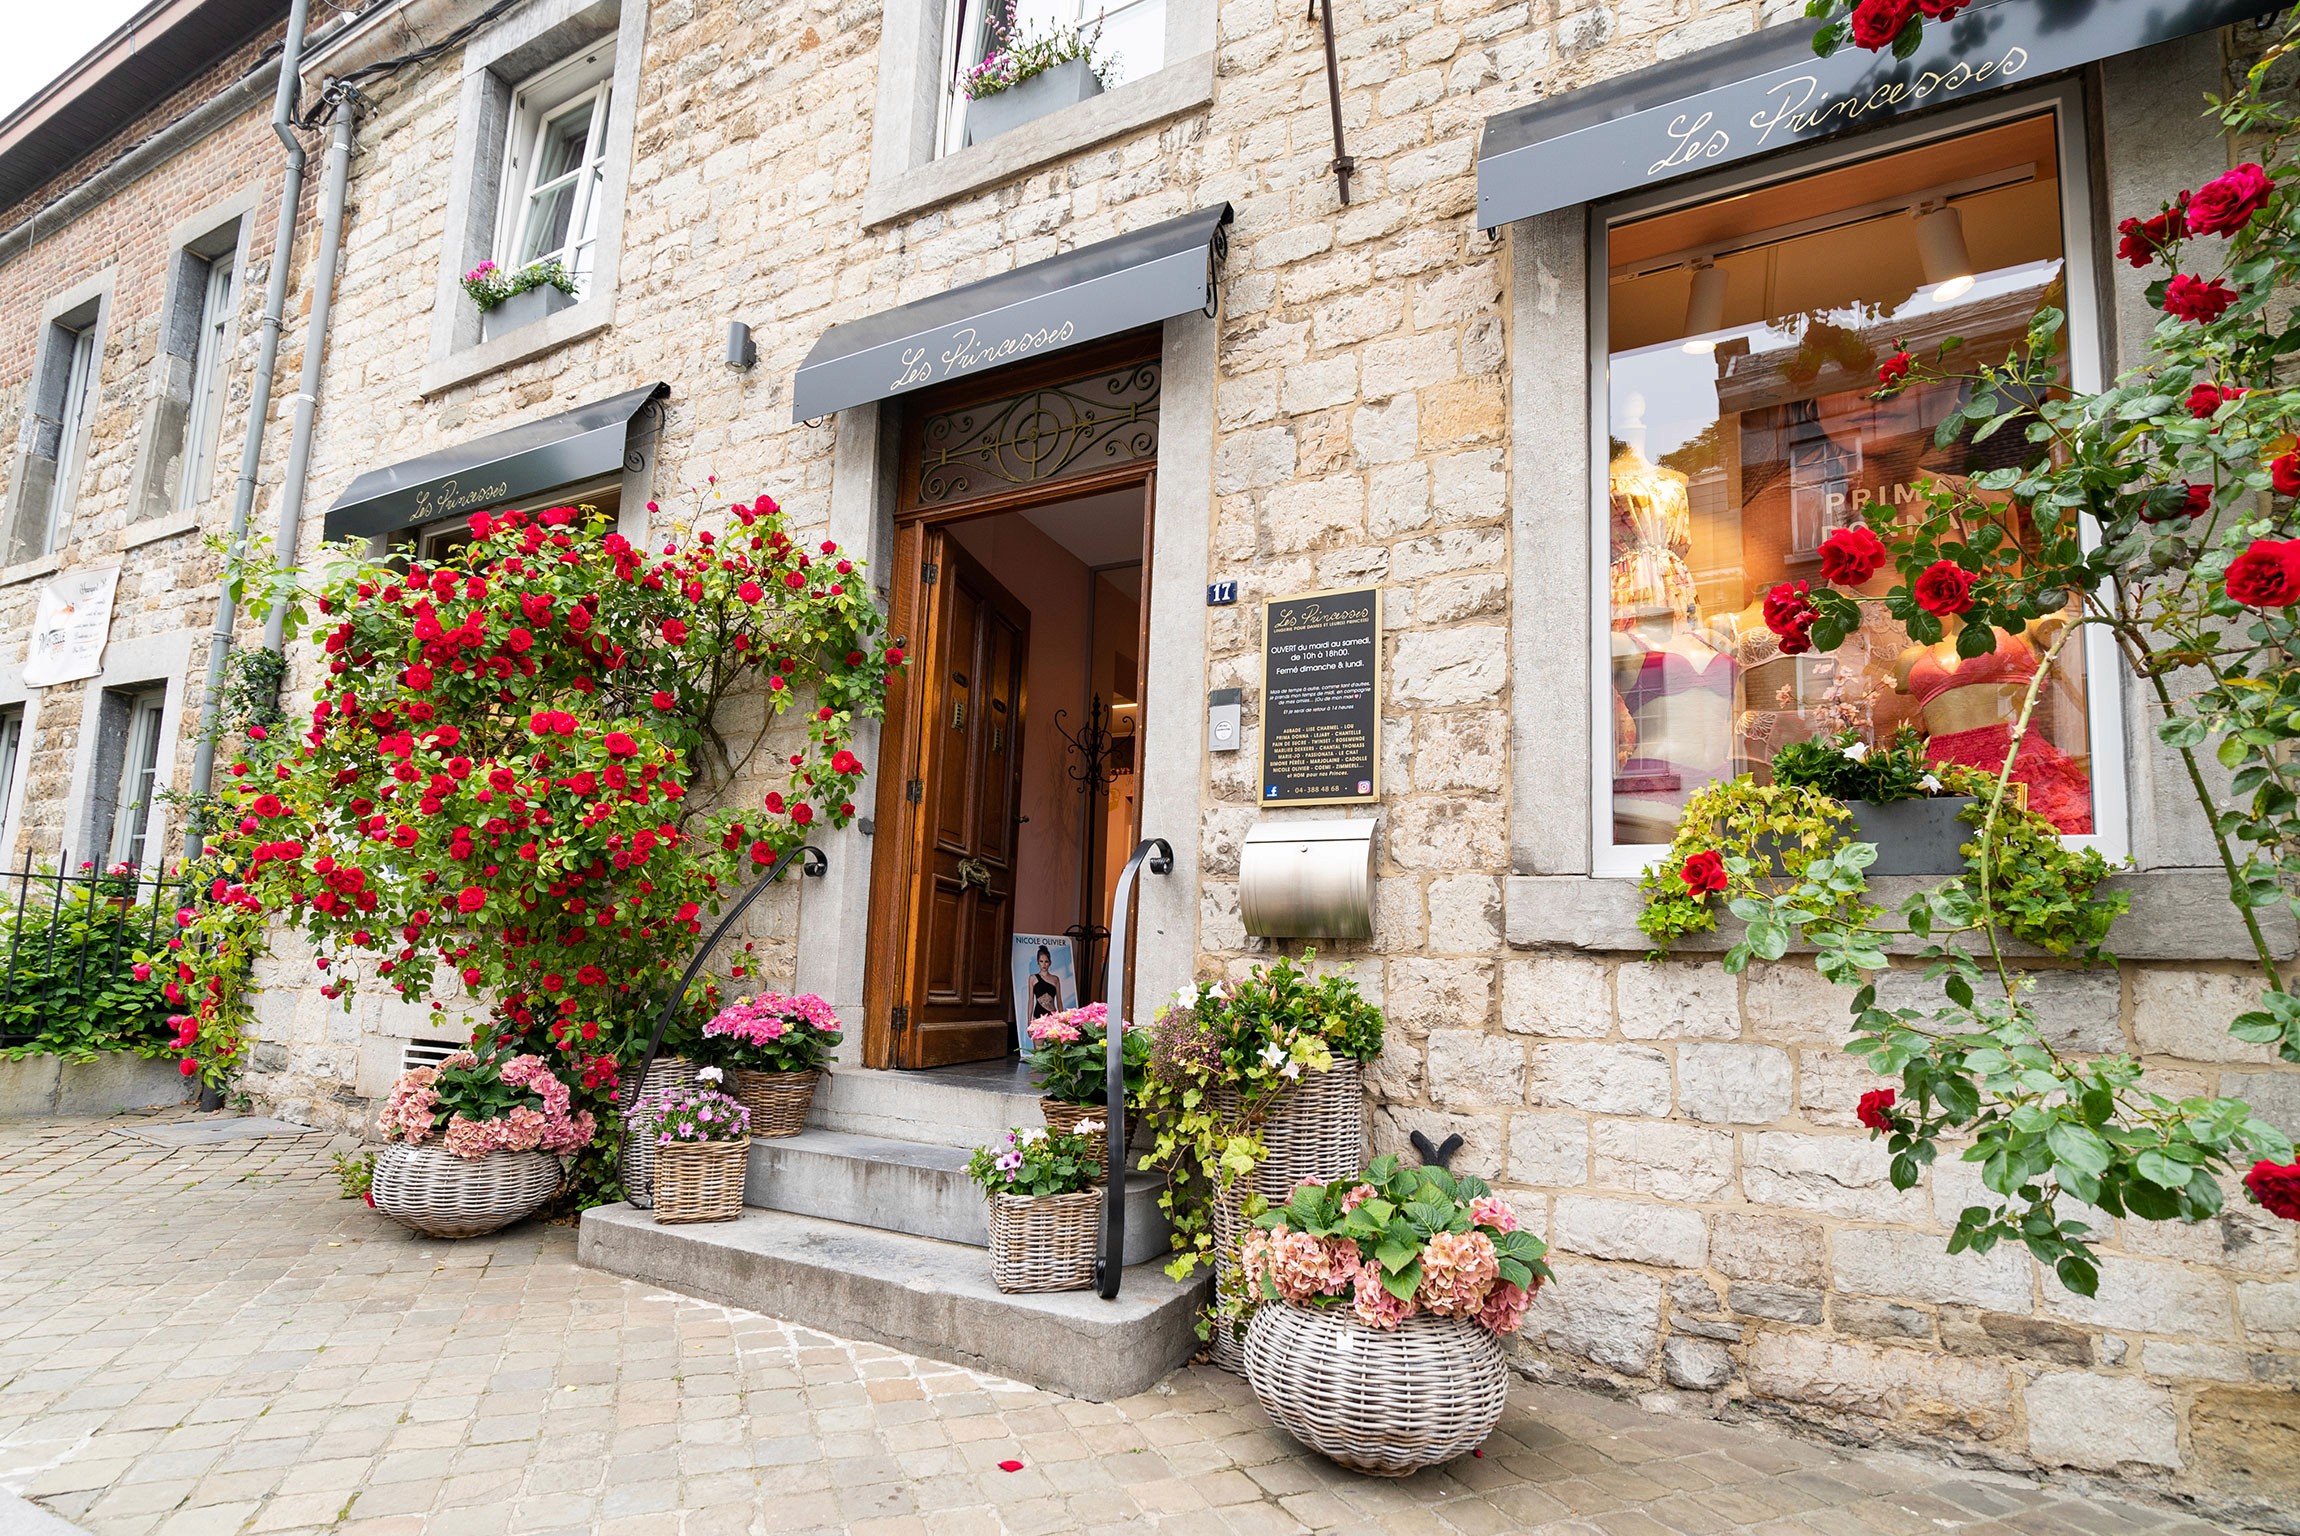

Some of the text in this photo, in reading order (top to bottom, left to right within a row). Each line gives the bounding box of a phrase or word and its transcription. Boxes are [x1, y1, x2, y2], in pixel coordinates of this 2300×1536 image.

[1647, 46, 2028, 175] Les Princesses
[890, 320, 1074, 390] Les Princesses
[409, 480, 507, 521] Les Princesses
[1825, 481, 1952, 514] PRIM
[1213, 583, 1231, 601] 17
[1274, 604, 1368, 628] Les Princesses
[1271, 645, 1296, 654] OUVERT
[1309, 641, 1329, 650] mardi
[1291, 649, 1349, 661] de 10h à 18h00.
[1276, 666, 1298, 674] Fermé
[1300, 662, 1336, 672] dimanche
[1345, 660, 1364, 668] lundi.
[1016, 937, 1066, 946] NICOLE OLIVIER
